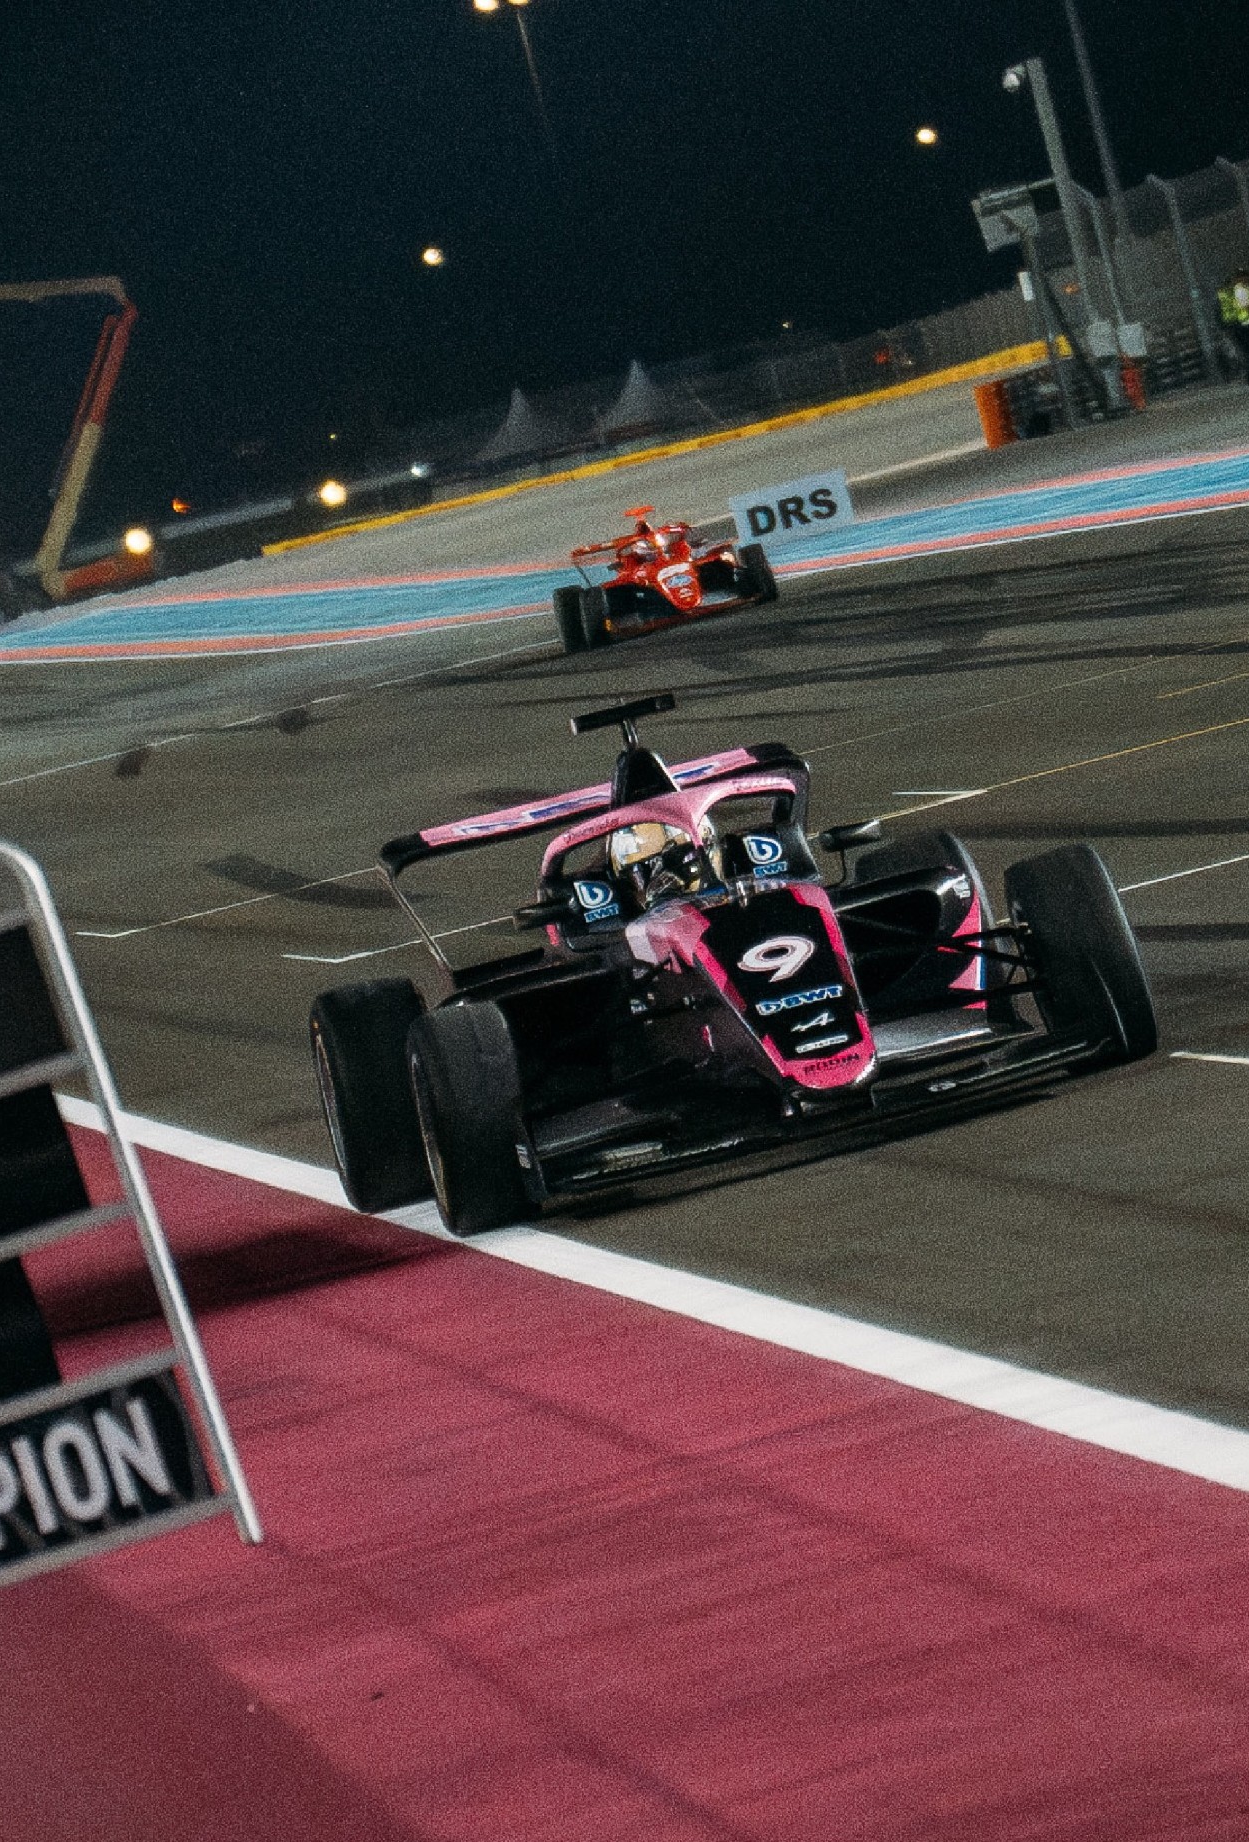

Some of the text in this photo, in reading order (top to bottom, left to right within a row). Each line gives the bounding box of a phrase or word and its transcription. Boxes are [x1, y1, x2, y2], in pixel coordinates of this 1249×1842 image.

[746, 488, 837, 536] DRS
[753, 861, 787, 878] BWT
[583, 903, 619, 922] BWT
[737, 936, 815, 982] 9
